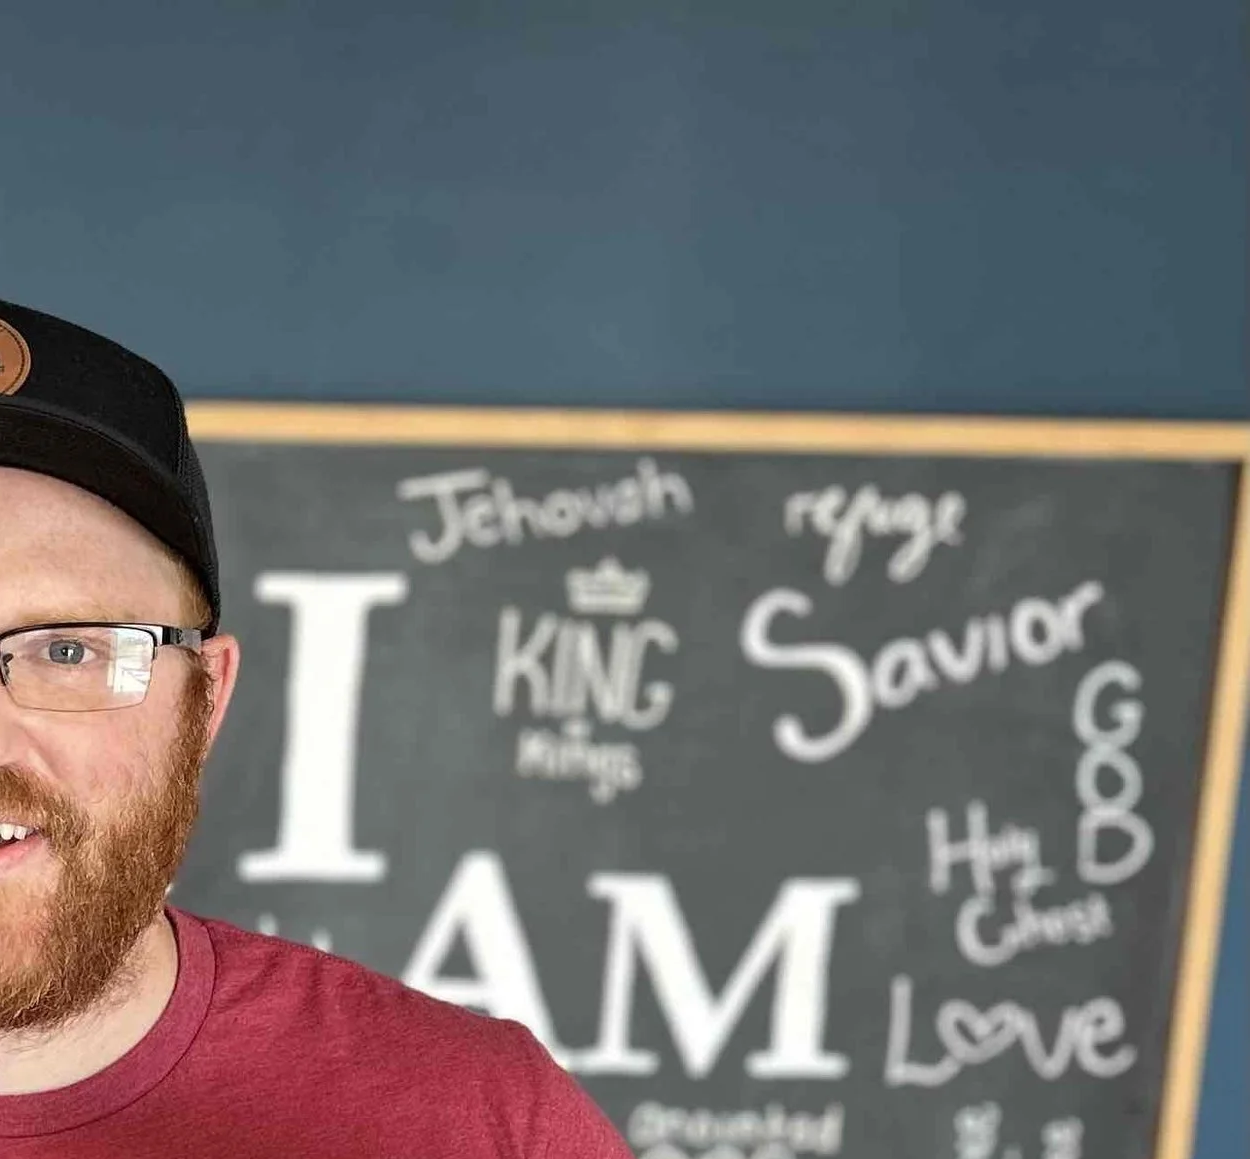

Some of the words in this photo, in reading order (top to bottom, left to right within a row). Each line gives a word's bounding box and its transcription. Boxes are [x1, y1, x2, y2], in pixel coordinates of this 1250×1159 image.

[396, 456, 694, 564] Jehovah
[237, 571, 410, 882] I
[493, 605, 679, 730] KING
[741, 581, 1105, 763] Savior
[1073, 661, 1154, 884] GOD
[400, 849, 862, 1080] AM
[884, 974, 1138, 1087] Love
